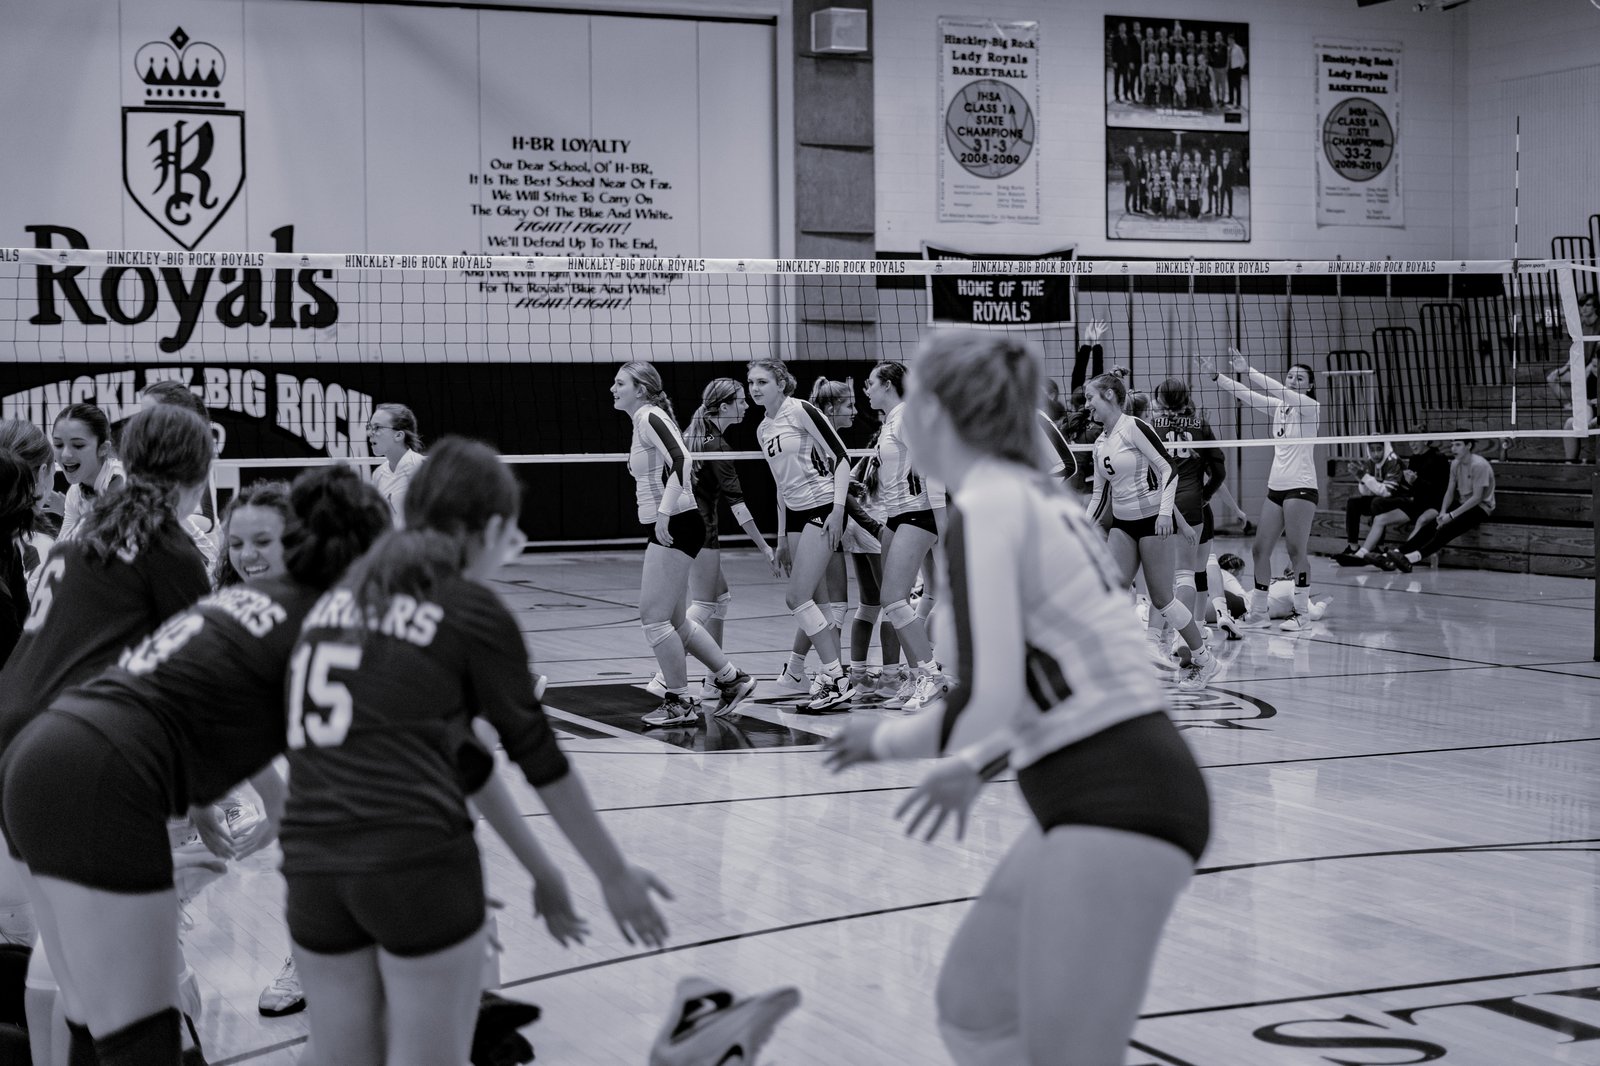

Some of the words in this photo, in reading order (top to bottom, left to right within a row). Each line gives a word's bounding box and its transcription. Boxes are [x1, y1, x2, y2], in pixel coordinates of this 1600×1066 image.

[944, 35, 1008, 49] Hinckley-Big
[1011, 37, 1035, 49] Rock
[952, 51, 982, 64] Lady
[987, 52, 1028, 65] Royals
[952, 67, 1028, 79] BASKETBALL
[1328, 69, 1352, 80] Lady
[1355, 69, 1389, 81] Royals
[1328, 84, 1388, 94] BASKETBALL
[977, 92, 1002, 103] IHSA
[964, 103, 997, 115] CLASS
[1003, 104, 1016, 115] 1A
[976, 115, 1004, 126] STATE
[1337, 116, 1366, 127] CLASS
[1369, 118, 1379, 127] 1A
[957, 127, 1023, 139] CHAMPIONS
[1347, 127, 1370, 138] STATE
[562, 138, 631, 153] LOYALTY
[973, 139, 1007, 153] 31-3
[1332, 137, 1385, 148] CHAMPIONS
[960, 153, 1020, 165] 2008-2009
[1344, 147, 1372, 160] 33-2
[490, 159, 513, 170] Our
[518, 159, 544, 171] Dear
[549, 160, 591, 173] School,
[469, 174, 479, 185] It
[484, 174, 494, 186] Is
[499, 174, 520, 186] The
[524, 175, 551, 187] Best
[556, 176, 595, 188] School
[600, 178, 626, 189] Near
[631, 178, 645, 190] Or
[650, 179, 672, 190] Far.
[492, 190, 512, 201] We
[516, 190, 540, 202] Will
[544, 191, 578, 203] Strive
[583, 192, 595, 204] To
[599, 193, 631, 207] Carry
[635, 194, 653, 205] On
[471, 204, 492, 216] The
[497, 205, 530, 221] Glory
[533, 206, 550, 217] Of
[555, 207, 575, 218] The
[579, 208, 604, 219] Blue
[607, 208, 631, 220] And
[635, 209, 673, 220] White.
[514, 221, 573, 233] FIGHT!
[573, 222, 632, 235] FIGHT!
[488, 236, 519, 247] We'll
[523, 236, 565, 249] Defend
[569, 237, 586, 251] Up
[591, 238, 604, 249] To
[608, 238, 630, 250] The
[633, 239, 658, 251] End,
[107, 251, 184, 265] HINCKLEY-BIG
[188, 252, 216, 266] ROCK
[221, 252, 264, 267] ROYALS
[345, 255, 417, 268] HINCKLEY-BIG
[422, 255, 447, 268] ROCK
[452, 256, 493, 269] ROYALS
[568, 258, 636, 271] HINCKLEY-BIG
[639, 258, 664, 271] ROCK
[668, 259, 706, 271] ROYALS
[776, 260, 840, 272] HINCKLEY-BIG
[843, 260, 866, 273] ROCK
[870, 260, 905, 273] ROYALS
[972, 261, 1032, 273] HINCKLEY-BIG
[1034, 261, 1056, 273] ROCK
[1060, 261, 1093, 273] ROYALS
[1156, 262, 1212, 273] HINCKLEY-BIG
[1214, 262, 1235, 273] ROCK
[1238, 262, 1270, 273] ROYALS
[1328, 261, 1381, 272] HINCKLEY-BIG
[1383, 261, 1403, 272] ROCK
[1406, 261, 1436, 272] ROYALS
[25, 224, 339, 353] Royals
[479, 282, 497, 293] For
[503, 282, 523, 294] The
[572, 283, 596, 294] Blue
[601, 284, 624, 294] And
[628, 284, 666, 295] White!
[957, 279, 994, 297] HOME
[999, 280, 1016, 297] OF
[1021, 279, 1045, 297] THE
[515, 296, 573, 310] FIGHT!
[573, 297, 632, 310] FIGHT!
[972, 301, 1031, 322] ROYALS
[276, 373, 373, 482] ROCK
[767, 435, 782, 457] 21
[286, 642, 363, 750] 15
